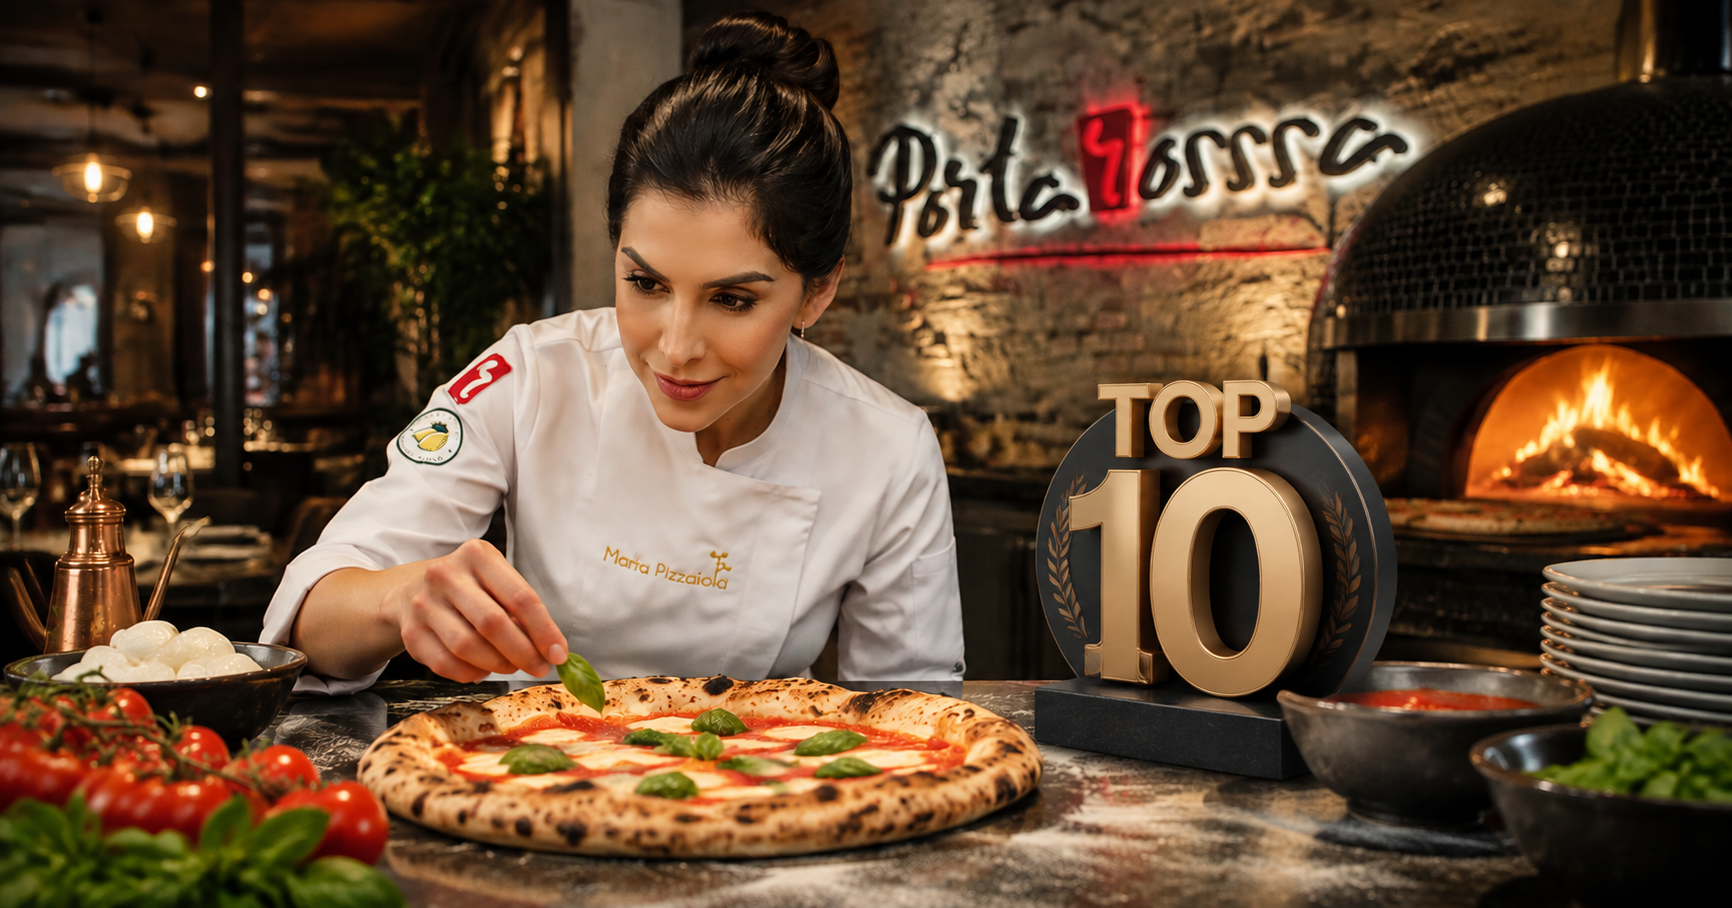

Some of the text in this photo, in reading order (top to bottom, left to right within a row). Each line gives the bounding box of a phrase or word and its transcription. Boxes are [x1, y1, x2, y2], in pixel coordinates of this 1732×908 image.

[868, 113, 1080, 246] Porta
[1097, 380, 1292, 460] TOP
[1068, 467, 1324, 698] 10
